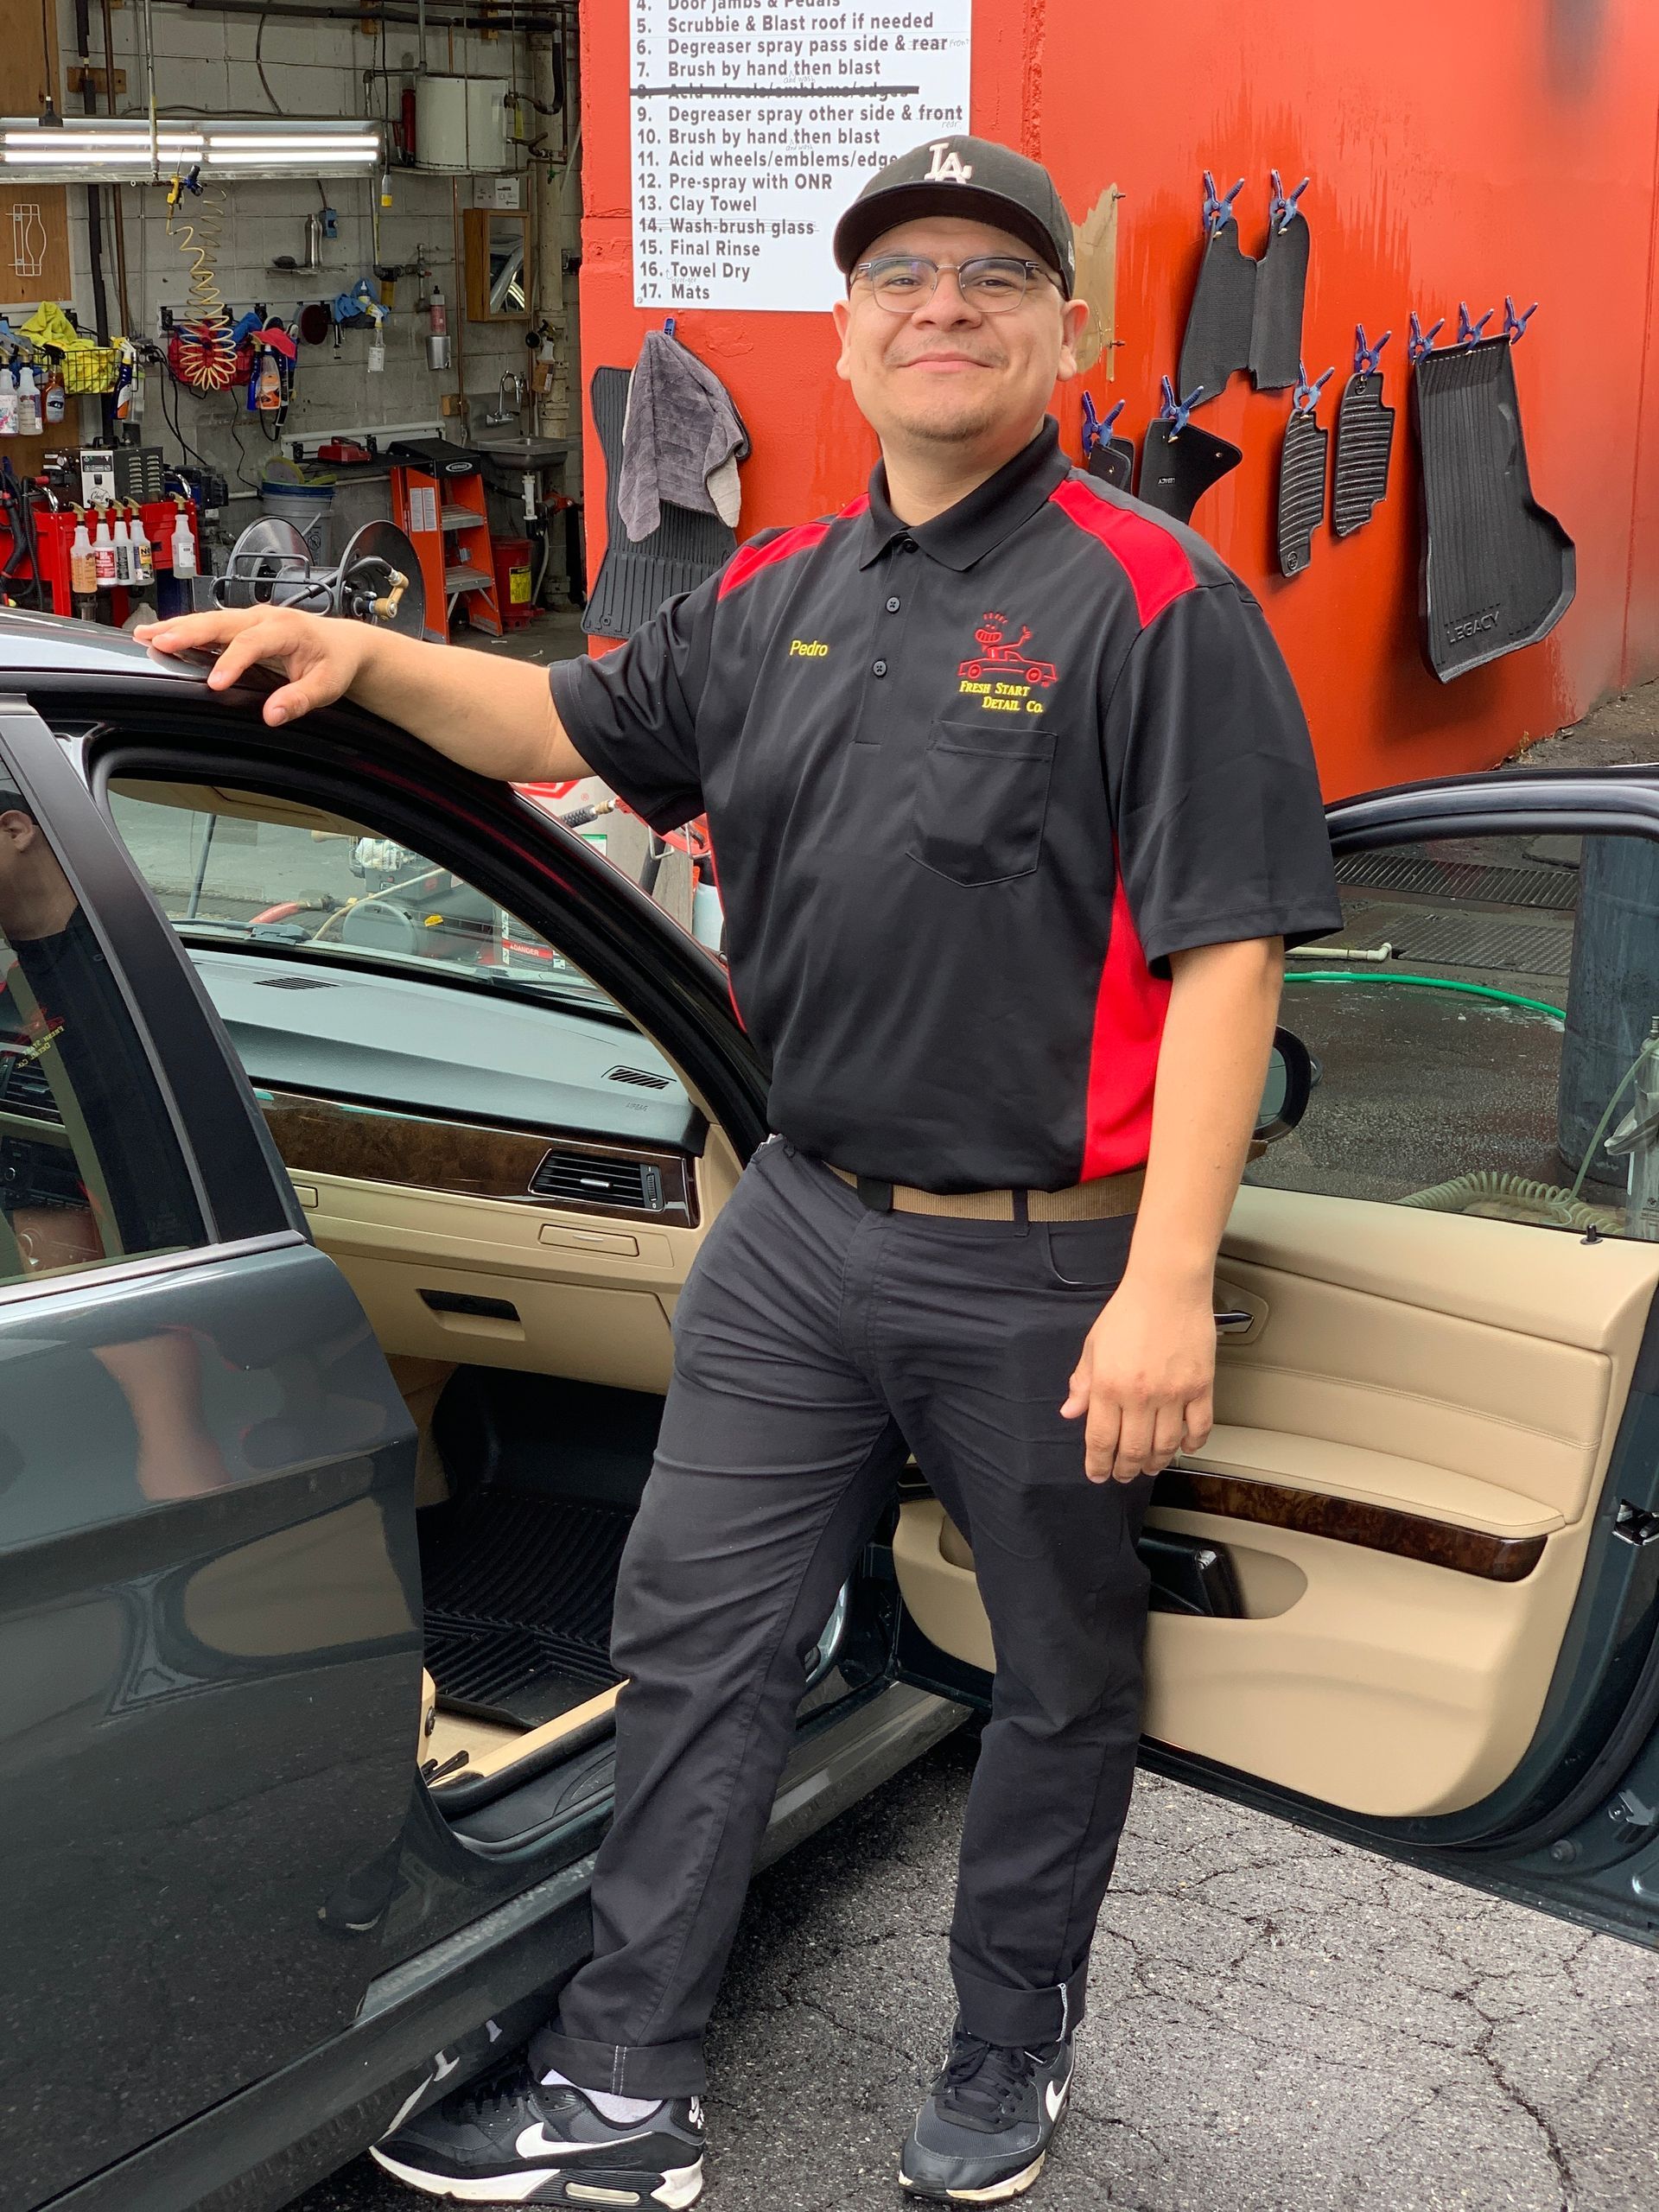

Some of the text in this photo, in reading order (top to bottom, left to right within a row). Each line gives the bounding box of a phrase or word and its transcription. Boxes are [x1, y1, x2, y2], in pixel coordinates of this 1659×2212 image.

[638, 0, 651, 10] 4.
[638, 12, 932, 33] 5. Scrubbie & Blast roof if needed
[638, 35, 947, 58] 6. Degreaser spray pass side & rear
[638, 60, 880, 79] 7. Brush by hand then blast
[638, 105, 962, 125] 9. Degreaser spray other side & front
[639, 129, 879, 148] 10. Brush by hand then blast
[639, 151, 899, 170] 11. Acid wheels/emblems/edge
[639, 173, 831, 193] 12. Pre-spray with ONR
[639, 195, 756, 214] 13. Clay Towel
[639, 218, 813, 238] 14. Wash-brush glass
[640, 239, 760, 256] 15. Final Rinse
[641, 262, 749, 282] 16. Towel Dry
[641, 283, 709, 299] 17. Mats
[1446, 610, 1499, 644] LEGACY
[789, 639, 828, 657] Pedro
